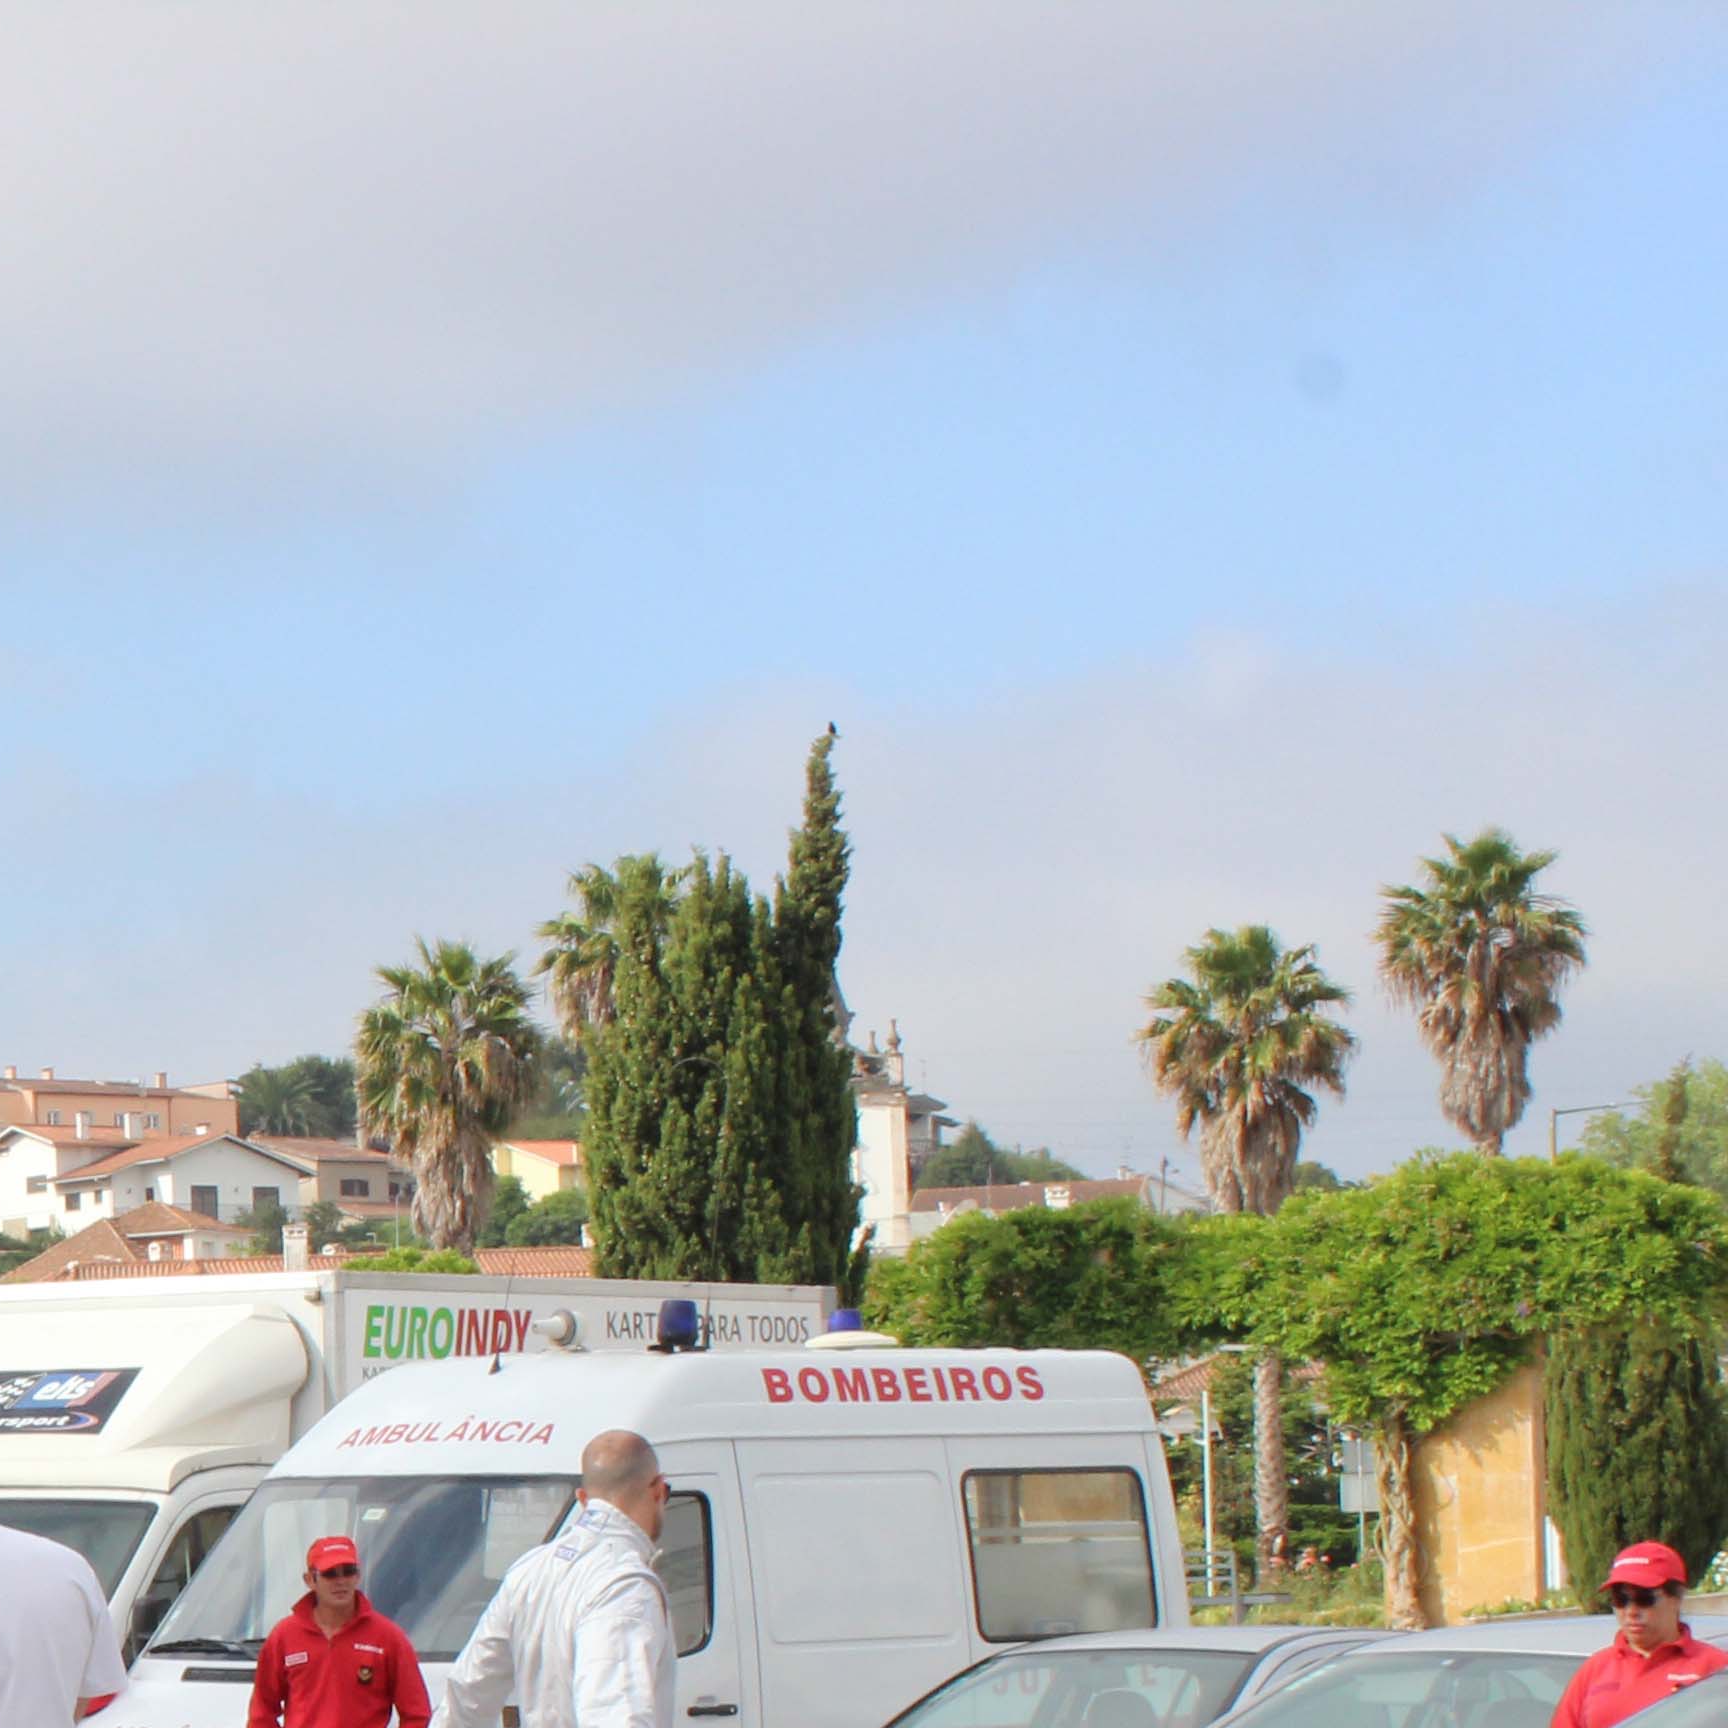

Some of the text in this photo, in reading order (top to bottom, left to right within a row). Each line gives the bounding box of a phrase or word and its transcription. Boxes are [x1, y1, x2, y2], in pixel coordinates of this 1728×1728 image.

[363, 1304, 533, 1360] EUROINDY
[747, 1315, 810, 1343] TODOS
[761, 1366, 1045, 1403] BOMBEIROS
[337, 1414, 556, 1451] AMBULÂNCIA
